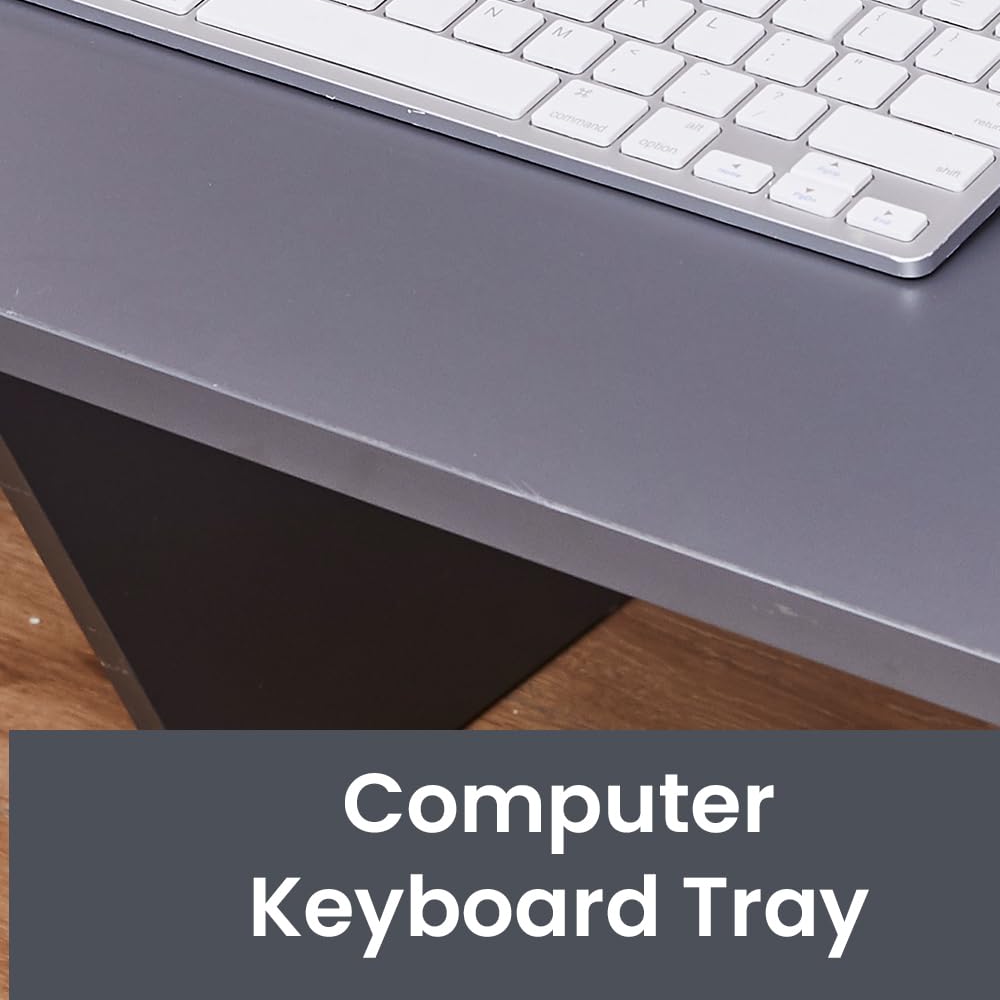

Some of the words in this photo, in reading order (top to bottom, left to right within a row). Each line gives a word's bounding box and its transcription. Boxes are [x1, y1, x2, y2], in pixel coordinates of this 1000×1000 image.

[484, 6, 504, 18] N
[706, 17, 718, 29] L
[552, 26, 573, 39] M
[550, 110, 609, 133] command
[639, 138, 679, 154] option
[936, 165, 961, 178] shift
